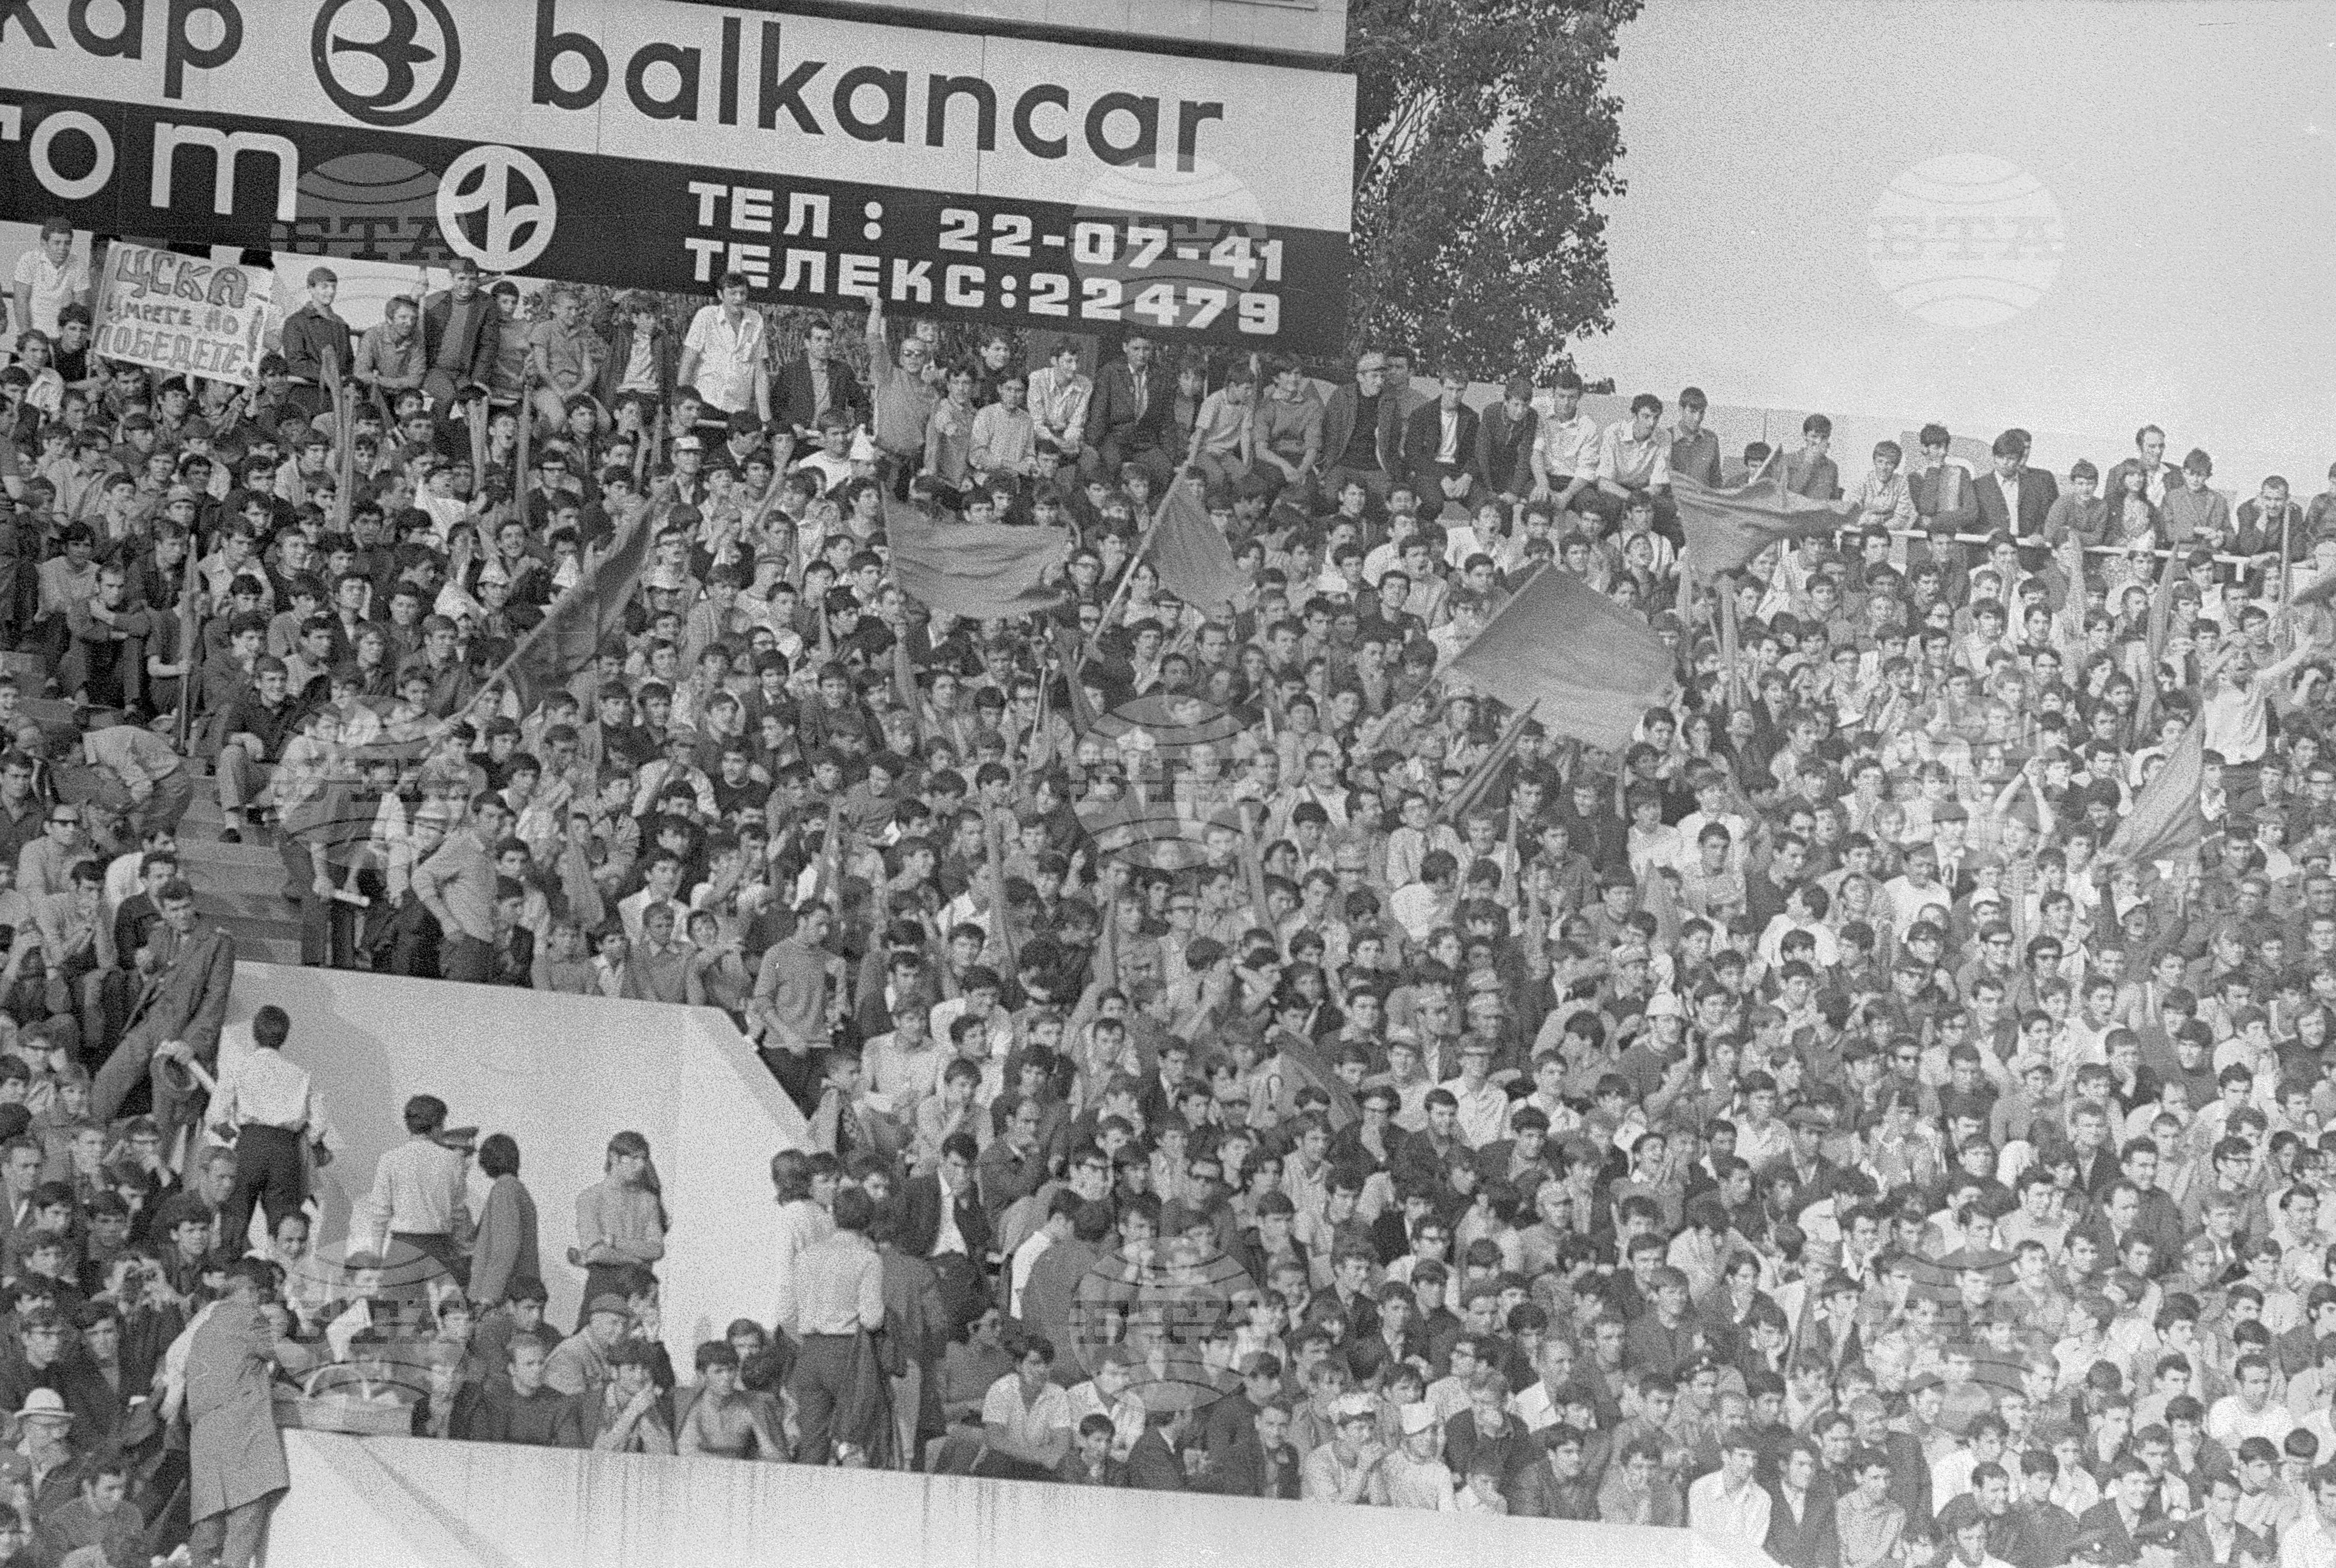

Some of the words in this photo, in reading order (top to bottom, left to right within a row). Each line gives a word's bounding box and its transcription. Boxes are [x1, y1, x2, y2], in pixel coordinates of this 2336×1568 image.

[532, 0, 1224, 172] balkancar
[116, 249, 248, 309] ЦСКА
[938, 207, 1283, 282] 22-07-41
